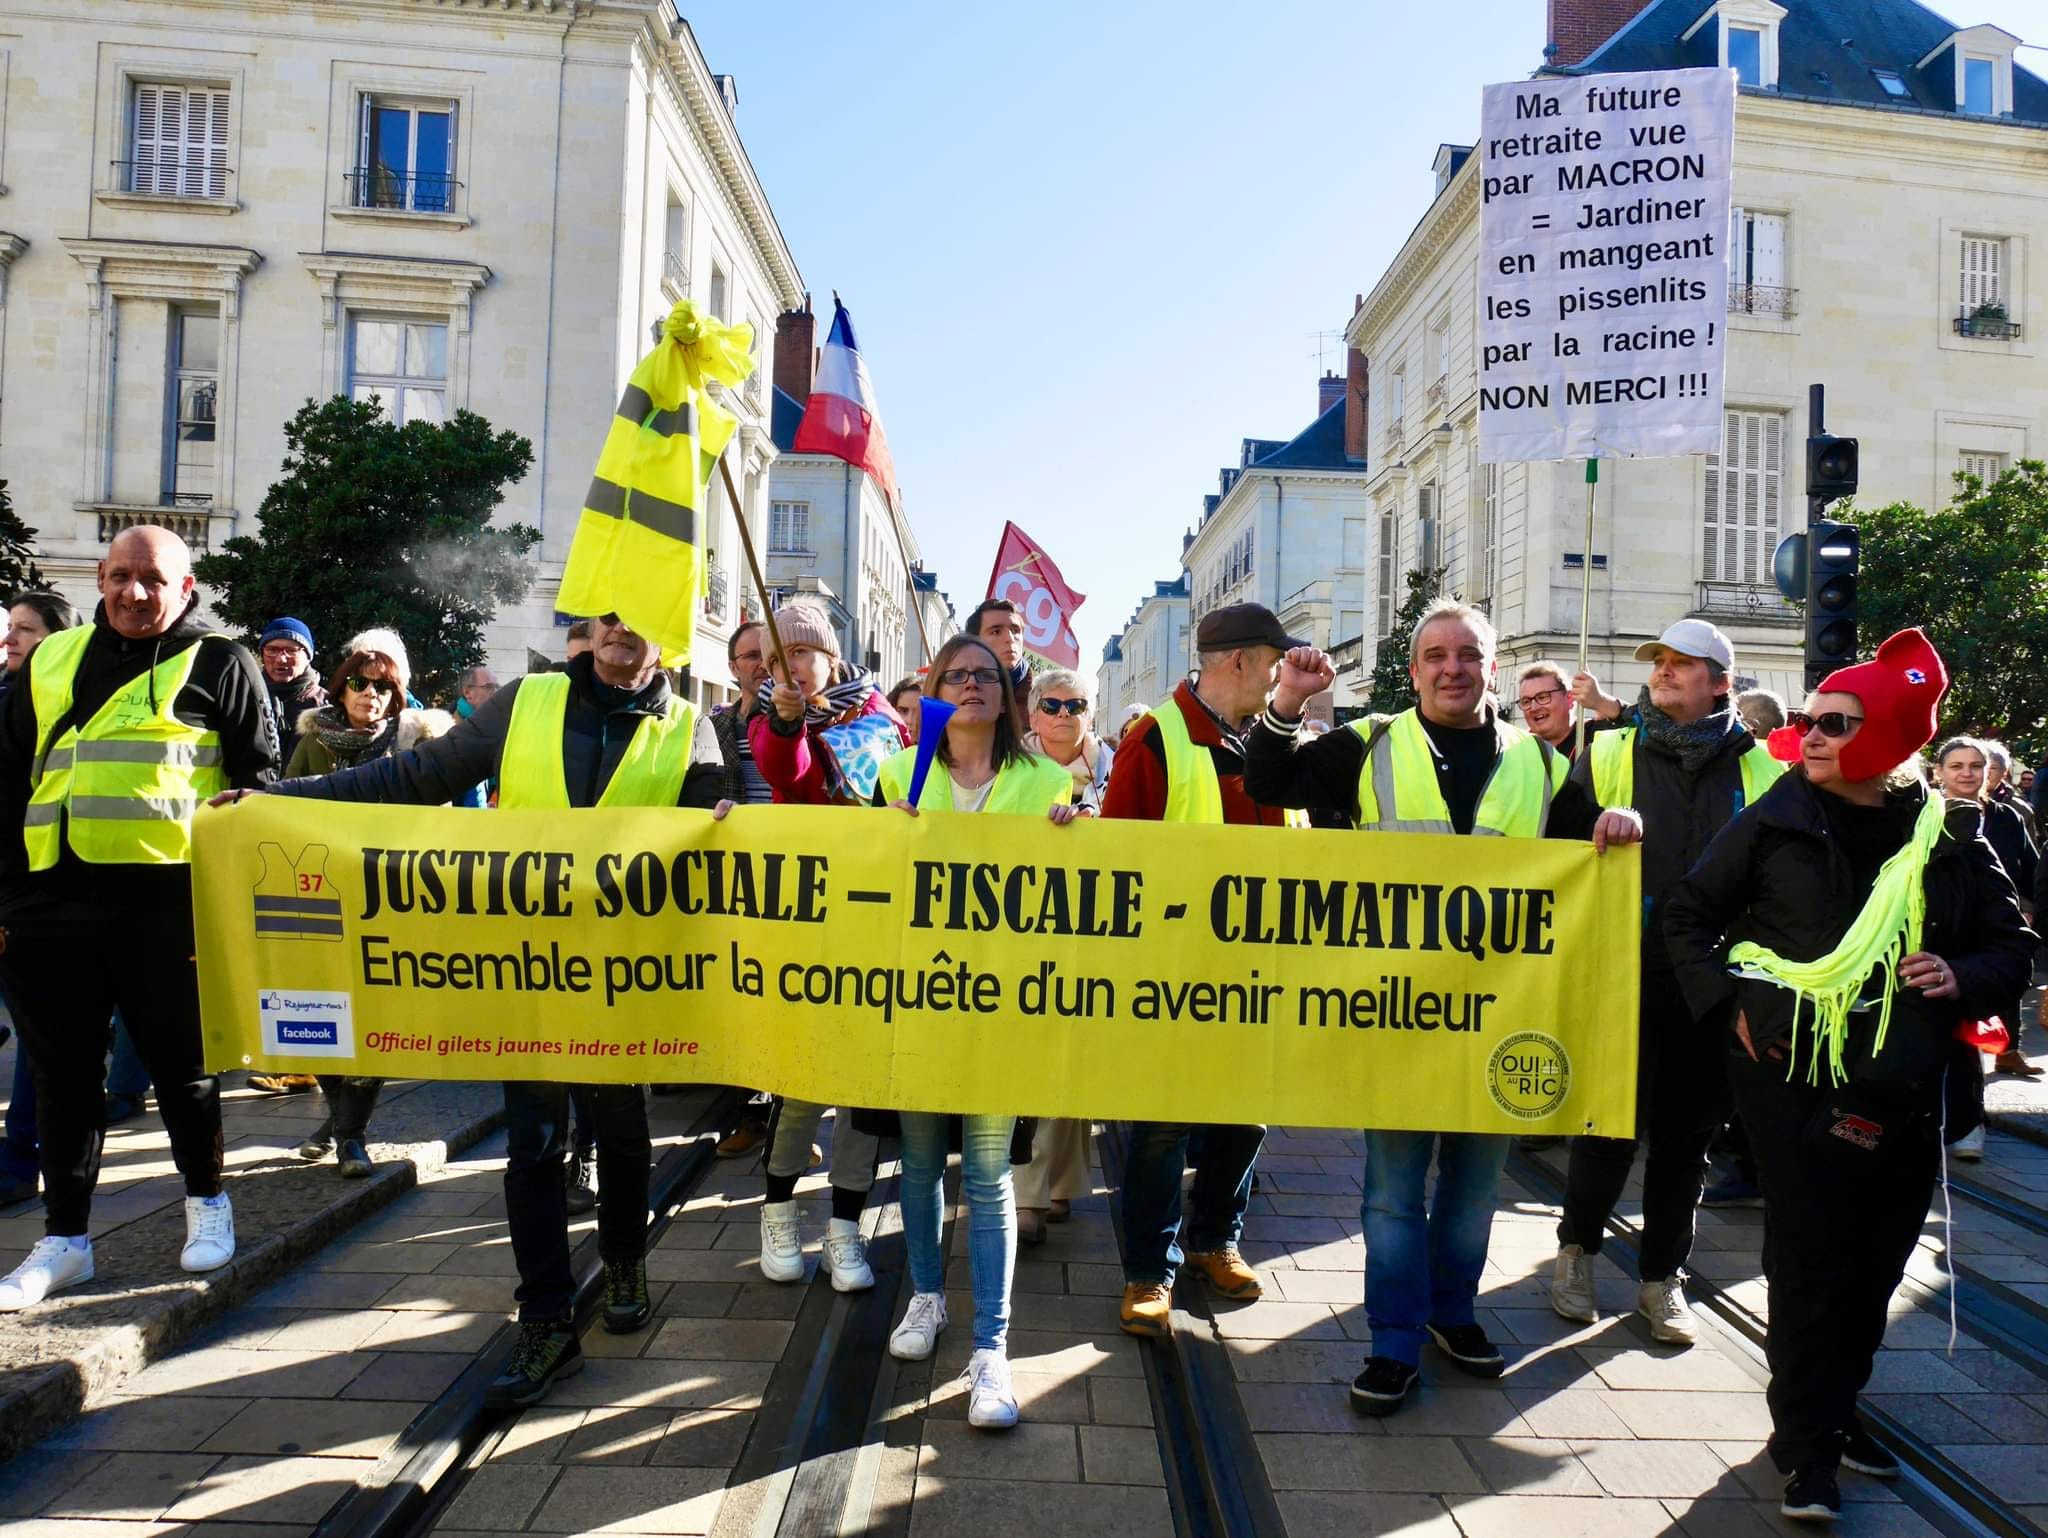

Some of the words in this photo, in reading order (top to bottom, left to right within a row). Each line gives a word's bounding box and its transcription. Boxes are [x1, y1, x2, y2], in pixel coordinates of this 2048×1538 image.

[1517, 94, 1561, 119] Ma
[1586, 87, 1680, 112] future
[1490, 127, 1601, 159] retraite
[1630, 125, 1686, 146] vue
[1484, 173, 1533, 203] par
[1559, 154, 1703, 191] MACRON
[1533, 215, 1550, 229] =
[1577, 198, 1705, 229] Jardiner
[1499, 254, 1534, 274] en
[1560, 233, 1713, 269] mangeant
[1488, 296, 1530, 320] les
[1560, 277, 1705, 320] pissenlits
[1484, 342, 1532, 371] par
[1555, 333, 1580, 356] la
[1604, 325, 1695, 352] racine
[1482, 385, 1548, 411] NON
[1567, 376, 1665, 405] MERCI
[299, 873, 323, 892] 37
[360, 848, 573, 920] JUSTICE
[595, 850, 828, 922] SOCIALE
[910, 860, 1143, 937] FISCALE
[1211, 874, 1554, 961] CLIMATIQUE
[361, 936, 592, 992] Ensemble
[605, 952, 717, 1006] pour
[732, 942, 763, 997] la
[779, 949, 1000, 1023] conquête
[1019, 961, 1114, 1018] d'un
[1132, 970, 1284, 1025] avenir
[1299, 975, 1497, 1032] meilleur
[283, 1027, 331, 1039] facebook
[366, 1032, 432, 1052] Officiel
[438, 1035, 492, 1056] gilets
[496, 1037, 562, 1056] jaunes
[569, 1039, 620, 1056] indre
[626, 1041, 646, 1056] et
[653, 1039, 698, 1056] loire
[1502, 1055, 1539, 1073] OUI
